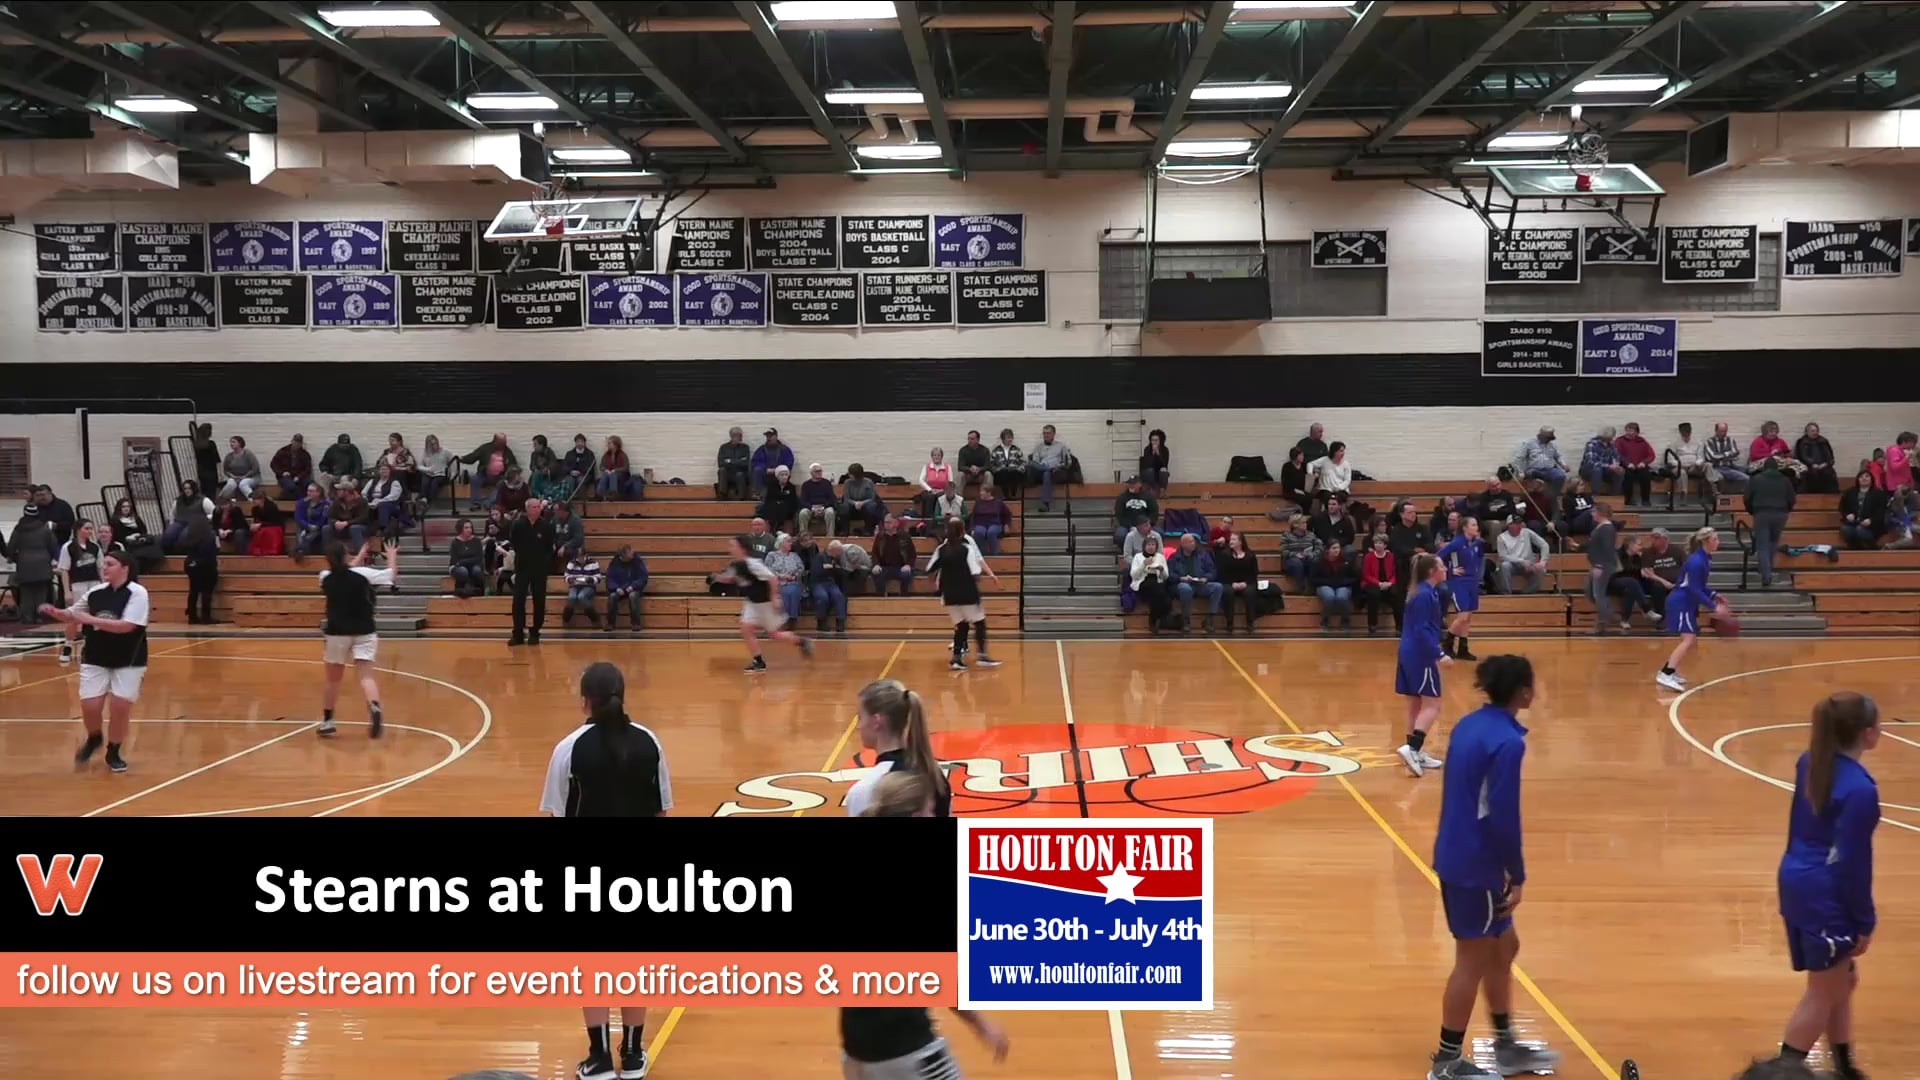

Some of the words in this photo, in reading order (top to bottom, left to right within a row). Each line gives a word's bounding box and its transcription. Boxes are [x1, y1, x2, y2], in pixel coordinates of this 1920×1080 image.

[389, 223, 436, 233] EASTERN
[439, 222, 471, 233] MAINE
[709, 221, 735, 229] MAINE
[761, 220, 798, 229] EASTERN
[802, 219, 826, 229] MAINE
[848, 221, 874, 229] STATE
[878, 220, 923, 229] CHAMPIONS
[938, 222, 956, 237] GOOD
[960, 216, 1018, 235] SPORTSMANSHIP
[122, 224, 166, 234] EASTERN
[967, 225, 991, 233] AWARD
[1672, 229, 1698, 238] STATE
[1702, 228, 1749, 238] CHAMPIONS
[403, 233, 461, 244] CHAMPIONS
[764, 230, 823, 239] CHAMPIONS
[846, 233, 867, 243] BOYS
[871, 232, 925, 242] BASKETBALL
[1525, 231, 1573, 240] CHAMPIONS
[135, 235, 190, 245] CHAMPIONS
[779, 240, 808, 248] 2004
[1677, 240, 1694, 249] PVC
[1698, 239, 1744, 248] CHAMPIONS
[688, 241, 716, 249] 2003
[863, 245, 897, 254] CLASS
[902, 245, 909, 253] C
[941, 243, 960, 251] EAST
[1520, 241, 1567, 250] CHAMPIONS
[1788, 233, 1858, 262] SPORTSMANSHIP
[1870, 237, 1899, 259] AWARD
[756, 249, 776, 257] BOYS
[780, 248, 832, 257] BASKETBALL
[1540, 251, 1573, 260] CHAMPIONS
[1717, 250, 1750, 259] CHAMPIONS
[404, 254, 460, 262] CHEERLEADING
[772, 258, 806, 266] CLASS
[872, 256, 900, 264] 2004
[1502, 262, 1529, 270] CLASS
[1542, 262, 1564, 270] GOLF
[1719, 260, 1741, 268] GOLF
[1794, 264, 1815, 274] BOYS
[1841, 262, 1893, 274] BASKETBALL
[412, 277, 450, 286] EASTERN
[452, 277, 476, 286] MAINE
[778, 278, 804, 287] STATE
[807, 278, 852, 287] CHAMPIONS
[867, 276, 892, 285] STATE
[896, 275, 947, 284] RUNNERS-UP
[964, 276, 991, 285] STATE
[994, 275, 1038, 284] CHAMPIONS
[526, 280, 580, 291] CHAMPIONS
[592, 282, 609, 296] GOOD
[613, 276, 671, 295] SPORTSMANSHIP
[619, 285, 643, 293] AWARD
[683, 280, 701, 295] GOOD
[704, 275, 762, 295] SPORTSMANSHIP
[415, 288, 473, 296] CHAMPIONS
[866, 286, 892, 295] EASTERN
[896, 286, 913, 295] MAINE
[917, 285, 949, 294] CHAMPIONS
[963, 287, 1039, 298] CHEERLEADING
[501, 292, 576, 303] CHEERLEADING
[776, 290, 855, 300] CHEERLEADING
[893, 296, 921, 304] 2004
[978, 300, 1013, 308] CLASS
[318, 302, 336, 310] EAST
[416, 306, 473, 314] CHEERLEADING
[516, 306, 550, 314] CLASS
[880, 305, 936, 313] SOFTBALL
[166, 317, 208, 327] BASKETBALL
[526, 317, 553, 325] 2002
[1488, 339, 1546, 350] SPORTSMANSHIP
[1548, 341, 1573, 349] AWARD
[1584, 350, 1608, 358] EAST
[1651, 349, 1672, 357] 2014
[711, 730, 1362, 818] SHIRS
